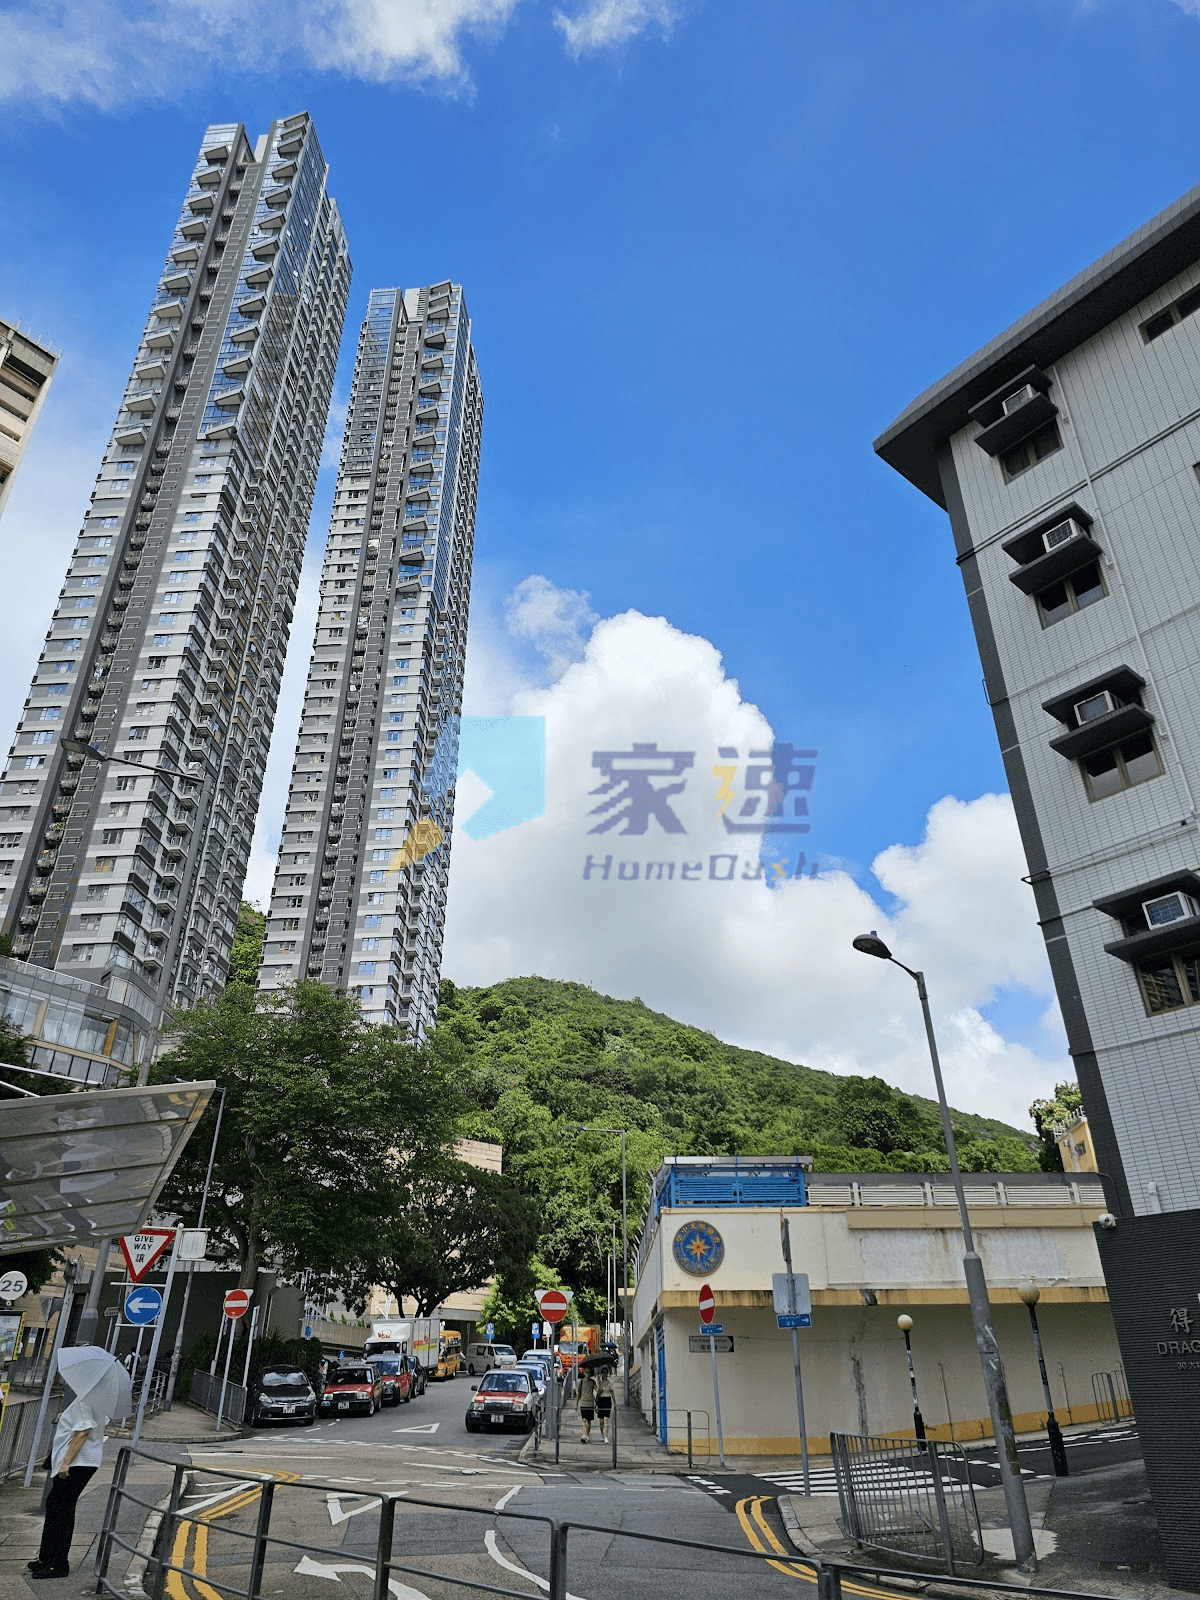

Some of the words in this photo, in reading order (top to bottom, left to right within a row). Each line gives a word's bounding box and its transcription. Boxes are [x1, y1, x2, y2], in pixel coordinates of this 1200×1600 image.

[134, 1235, 155, 1243] GIVE
[133, 1243, 153, 1251] WAY
[1, 1280, 24, 1293] 25
[1169, 1308, 1194, 1333] 得
[1157, 1340, 1200, 1355] DRAG
[1177, 1361, 1187, 1370] 30
